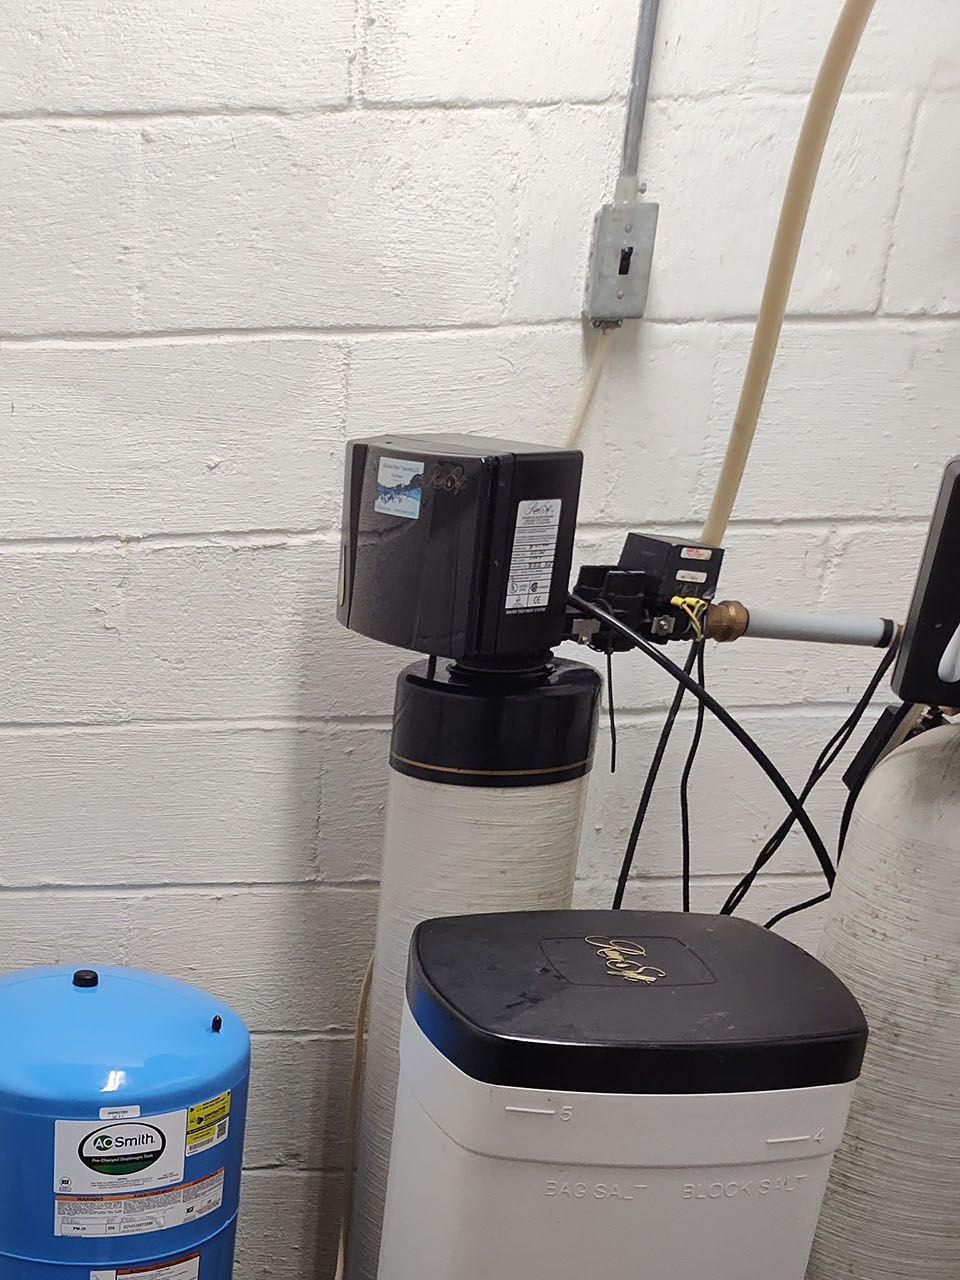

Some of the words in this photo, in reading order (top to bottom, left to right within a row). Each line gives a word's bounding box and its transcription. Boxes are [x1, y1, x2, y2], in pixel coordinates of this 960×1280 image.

[559, 1105, 573, 1121] 5
[114, 1133, 154, 1149] Smith
[813, 1126, 825, 1144] 4
[544, 1180, 586, 1199] BAG
[592, 1183, 648, 1201] SALT
[683, 1180, 753, 1199] BLOCK
[758, 1174, 807, 1195] SALT
